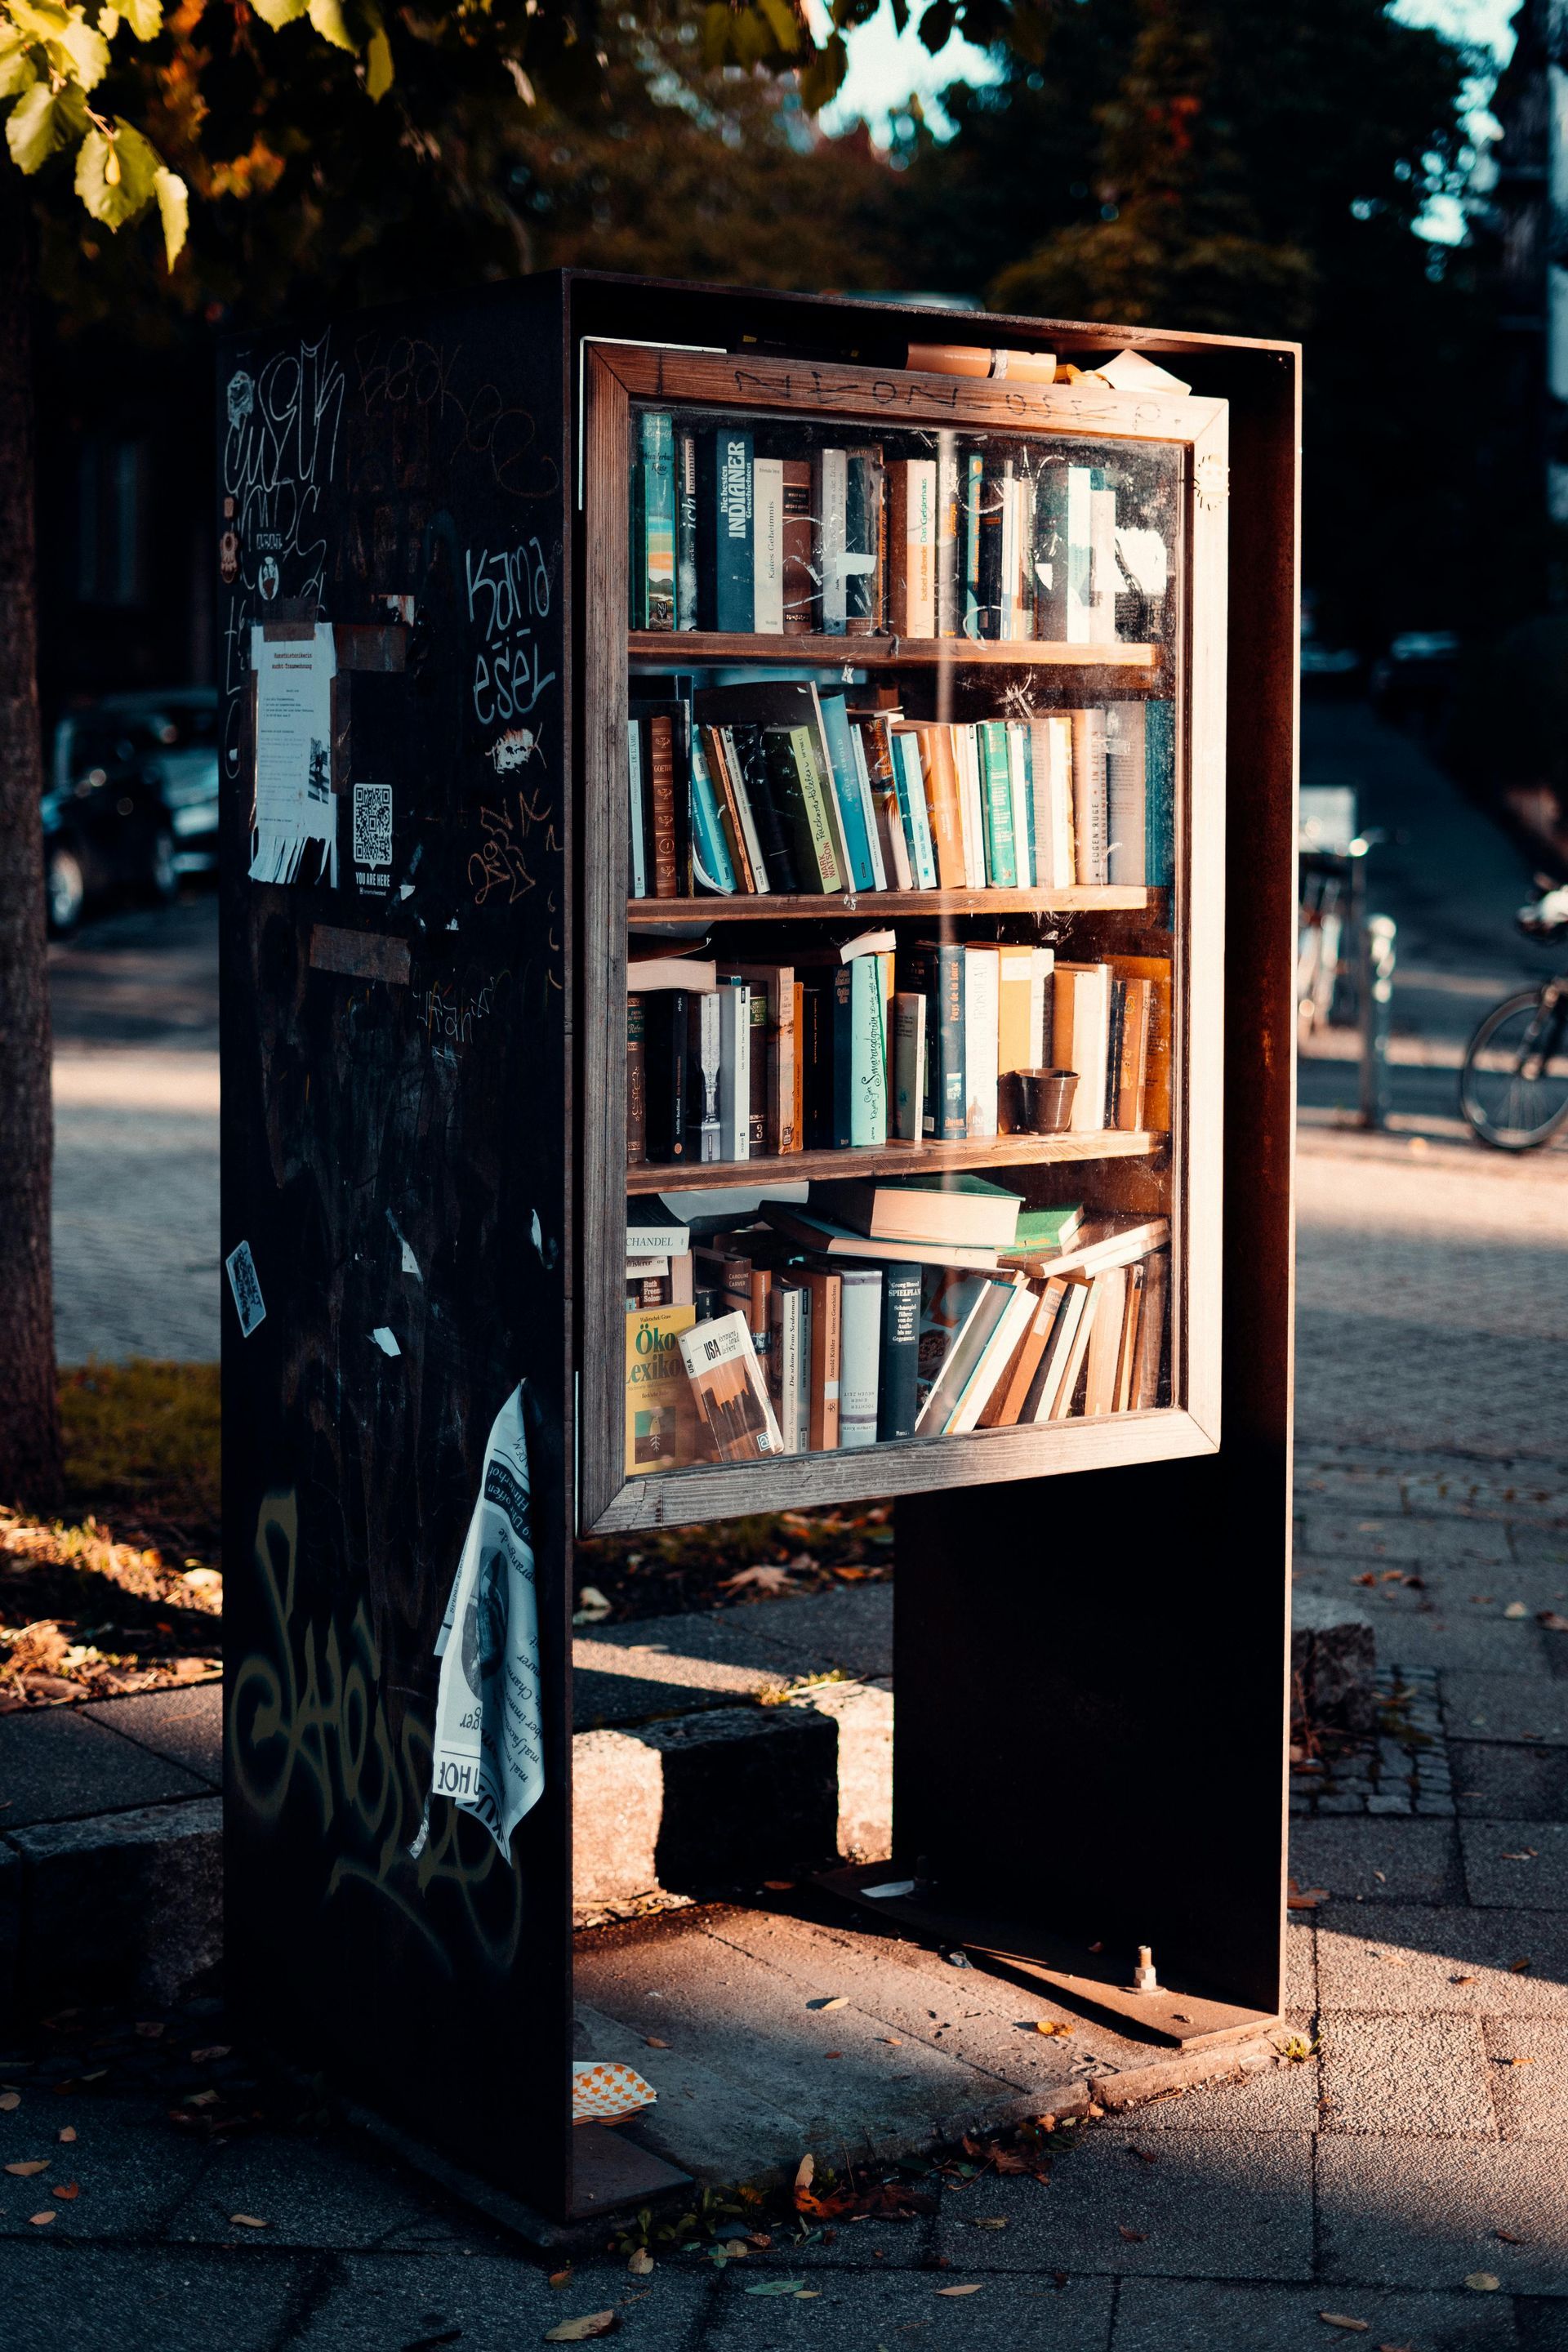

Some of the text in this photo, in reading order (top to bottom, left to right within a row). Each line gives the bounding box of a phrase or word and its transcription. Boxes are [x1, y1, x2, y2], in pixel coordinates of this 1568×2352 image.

[682, 442, 696, 530] ich hannibal
[728, 441, 746, 539] INDIANER
[920, 478, 928, 543] Das Geisterhaus
[920, 546, 928, 602] Isabel Allende
[631, 755, 637, 764] DE
[653, 764, 672, 773] GOETHE
[835, 737, 853, 804] ALICE SEBOLD
[1091, 770, 1099, 782] IN
[1091, 803, 1099, 828] RUGE
[822, 841, 837, 879] WATSON
[1091, 833, 1099, 863] EUGEN
[817, 853, 830, 880] MARK
[355, 871, 390, 888] YOU ARE HERE
[950, 992, 959, 1001] de
[950, 1004, 959, 1022] Pays
[861, 1015, 882, 1087] Smaragdgrün
[755, 1124, 764, 1138] 3
[889, 1288, 921, 1298] SPIELPLAN
[635, 1323, 676, 1355] Öko
[703, 1339, 722, 1361] USA
[686, 1358, 694, 1374] USA
[488, 1466, 529, 1512] Hinterhof
[487, 1483, 523, 1528] Uhr offen
[517, 1744, 540, 1765] mal
[509, 1762, 529, 1783] mal
